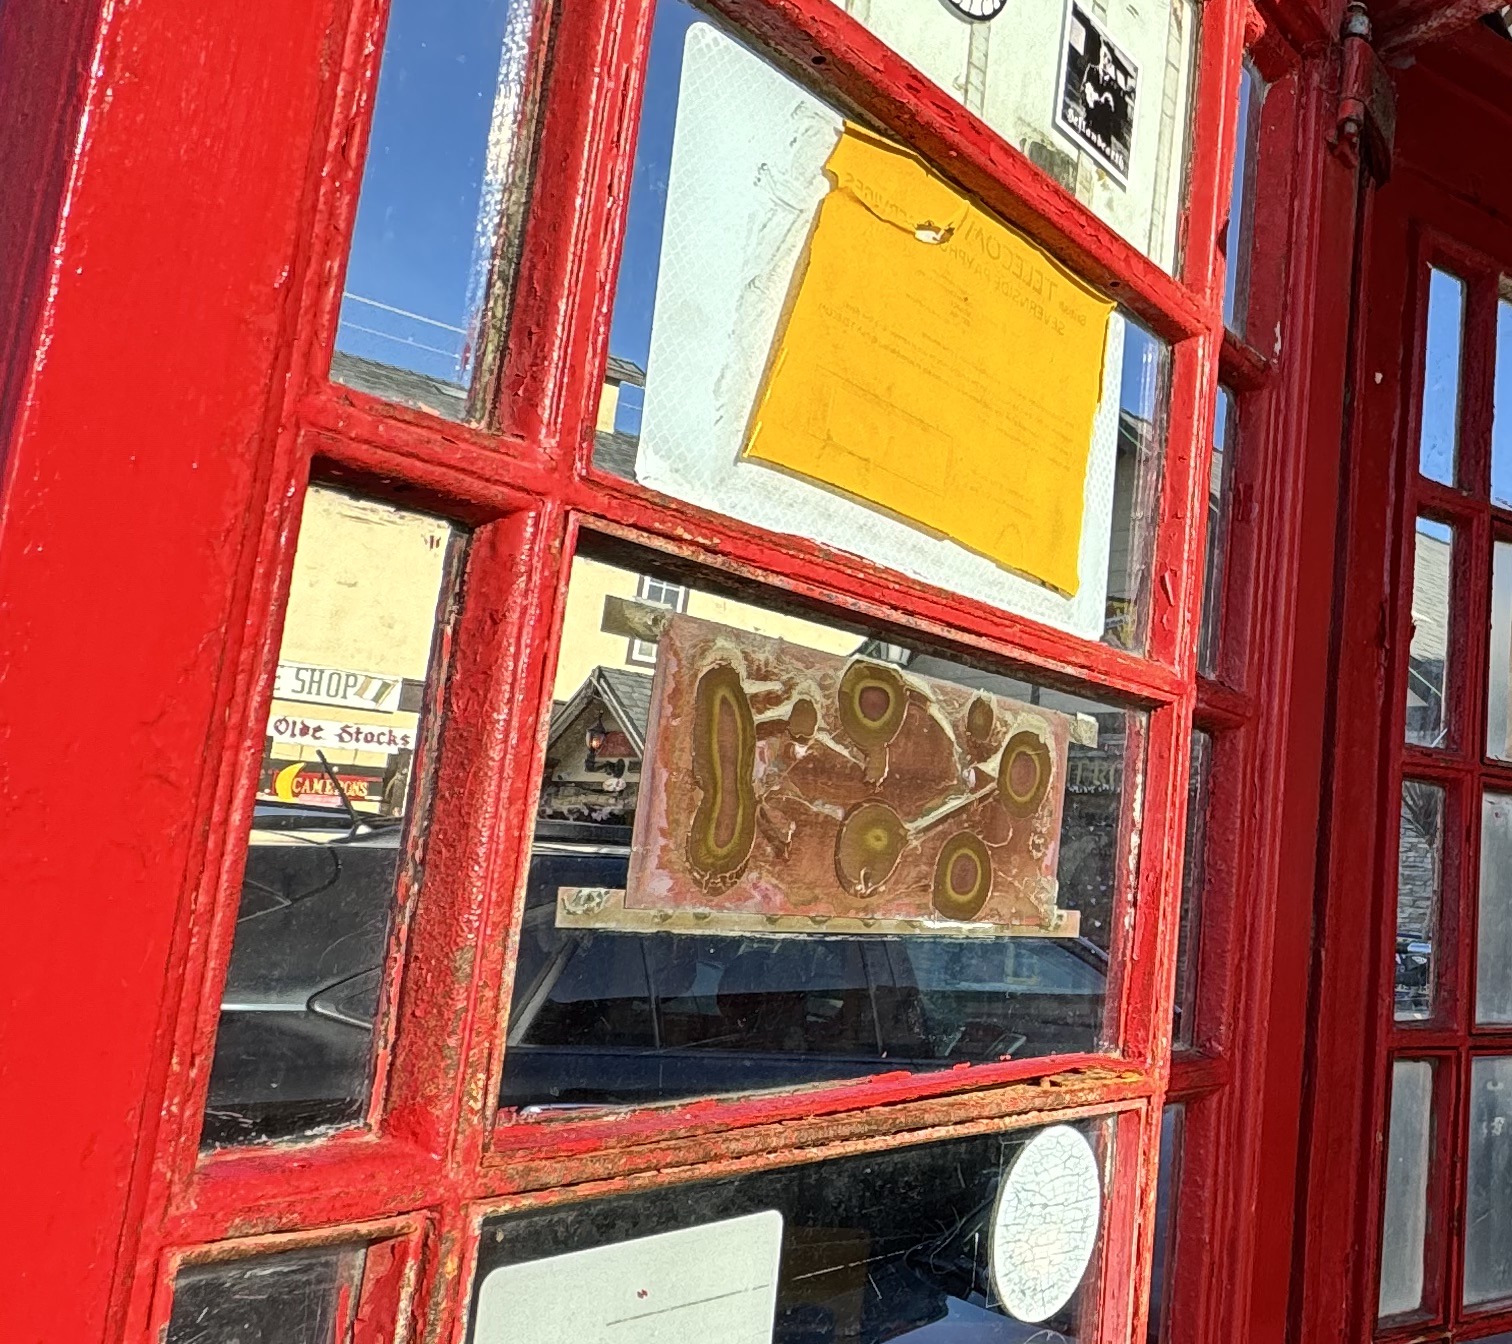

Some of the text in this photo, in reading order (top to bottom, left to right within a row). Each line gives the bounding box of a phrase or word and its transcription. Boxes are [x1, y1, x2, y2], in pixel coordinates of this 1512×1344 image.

[291, 667, 358, 699] SHOP
[273, 716, 411, 746] Olde Stocks
